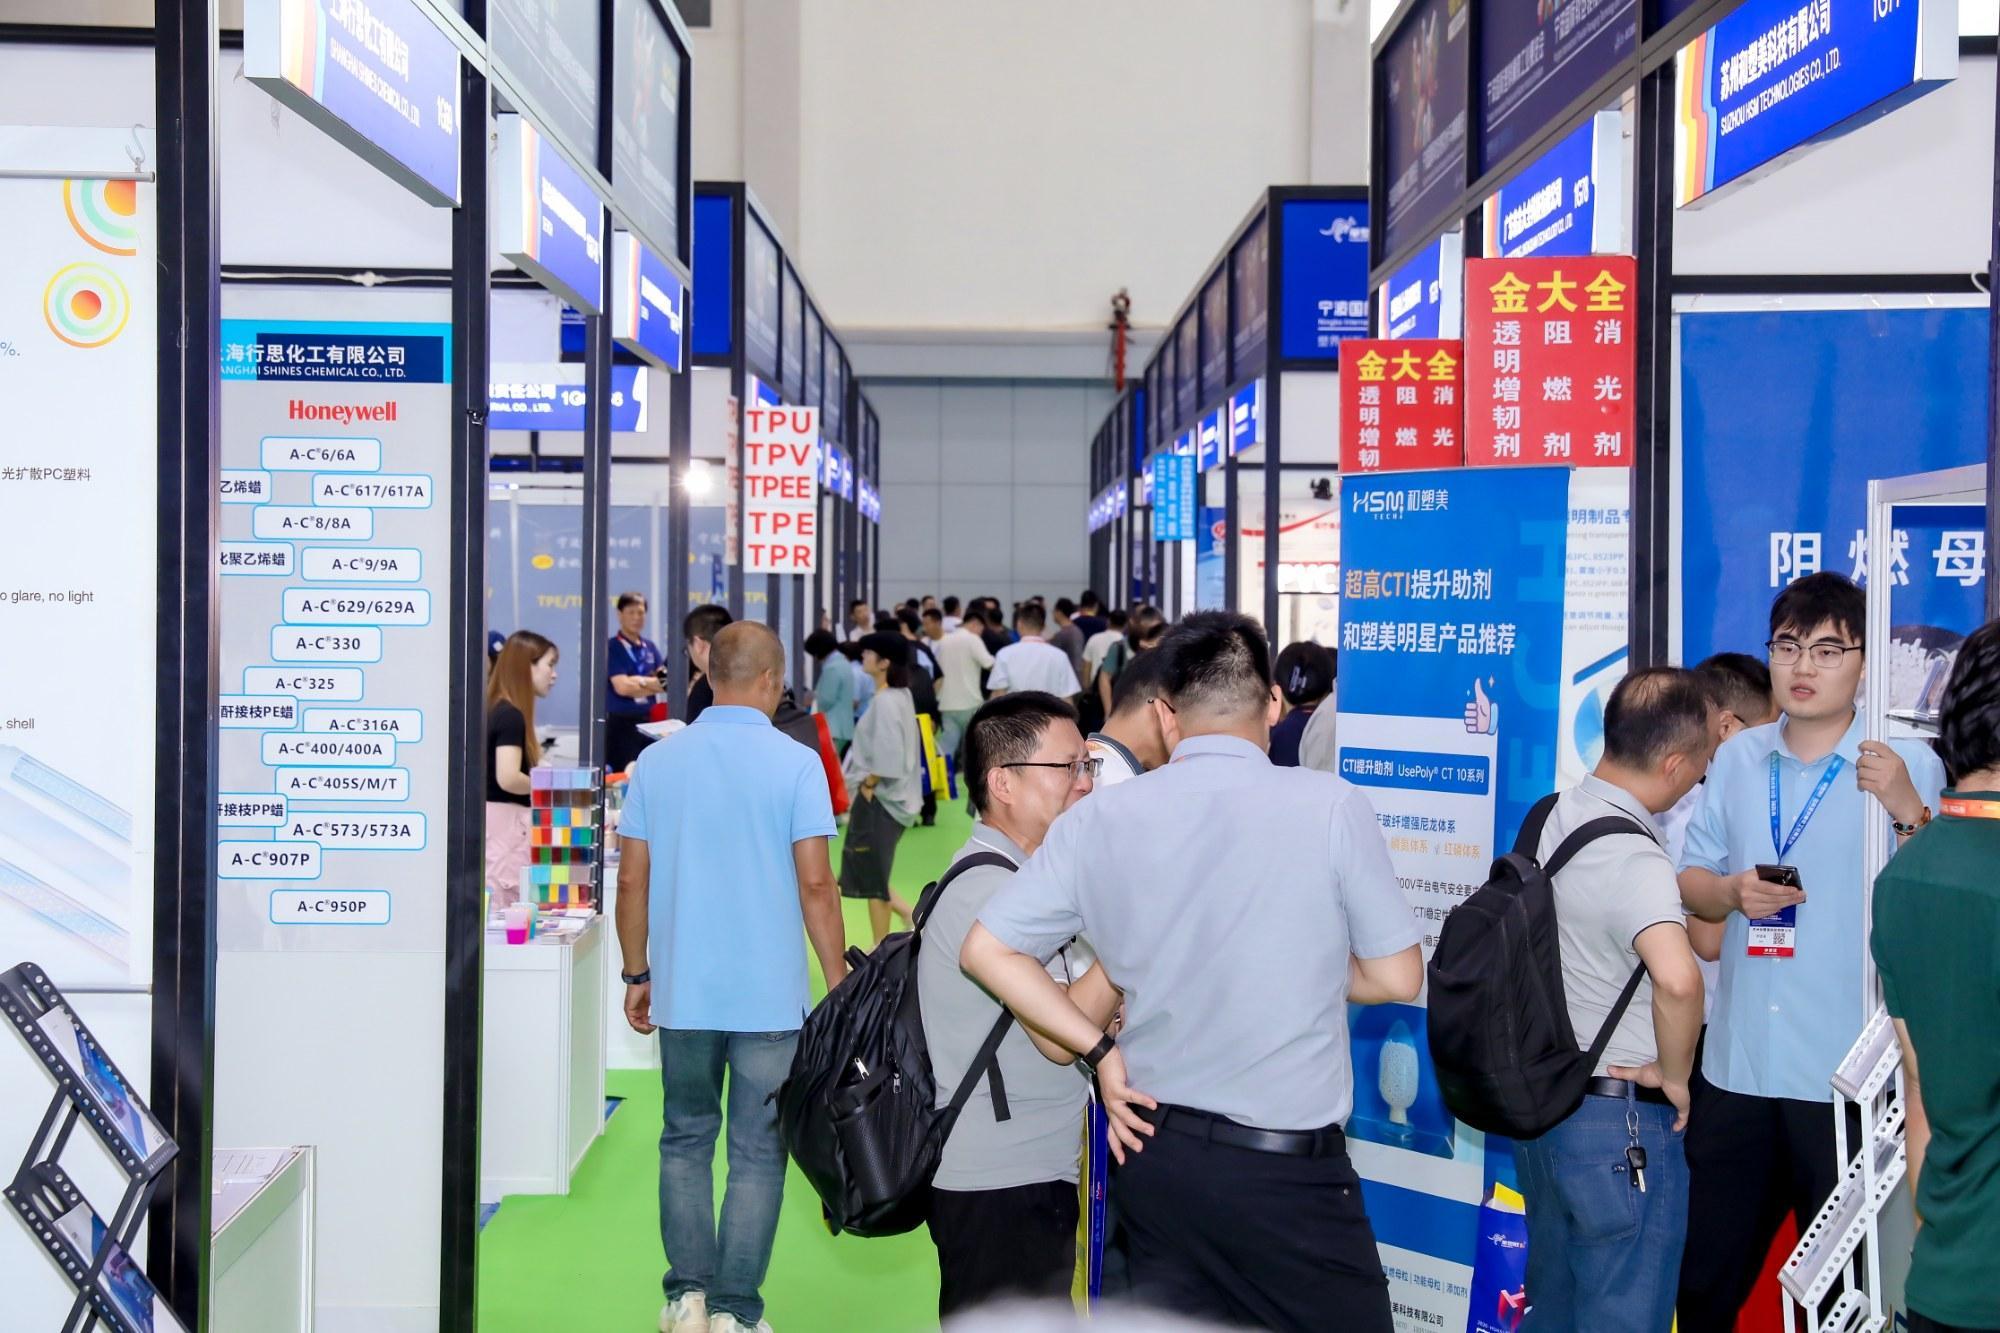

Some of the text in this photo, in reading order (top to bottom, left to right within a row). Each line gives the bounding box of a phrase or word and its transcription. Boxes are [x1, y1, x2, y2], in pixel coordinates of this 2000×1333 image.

[1720, 105, 1745, 137] SUZHOU
[1760, 64, 1810, 113] TECHNOLOGIES
[1489, 269, 1627, 313] 金大全
[221, 343, 406, 365] 海行思化工有限公司
[1356, 349, 1458, 381] 金大全
[263, 366, 302, 376] SHINES
[304, 366, 360, 377] CHEMICAL
[385, 368, 407, 378] LTD.
[1492, 320, 1522, 458] 透明增韧剂
[1542, 320, 1573, 458] 阻燃剂
[1593, 319, 1623, 457] 消光剂
[289, 400, 397, 425] Honeywell
[746, 410, 811, 434] TPU
[1358, 385, 1381, 472] 透明增韧
[746, 443, 811, 466] TPV
[1, 466, 91, 481] 光扩散PC塑料
[220, 480, 262, 494] 乙烯蜡
[745, 475, 811, 498] TPEE
[1407, 488, 1449, 512] 和塑美
[748, 512, 814, 536] TPE
[1566, 508, 1630, 526] 明制品
[748, 544, 812, 568] TPR
[1345, 568, 1492, 600] 超高CTI提升助剂
[11, 590, 45, 604] glare,
[48, 592, 65, 602] no
[68, 590, 95, 605] light
[1343, 621, 1517, 655] 和塑美明星产品推荐
[6, 717, 35, 729] shell
[1342, 758, 1394, 777] CTI提升助剂
[1441, 767, 1454, 781] CT
[1456, 768, 1485, 784] 10系列
[1396, 877, 1480, 897] 00V平台电气安全要
